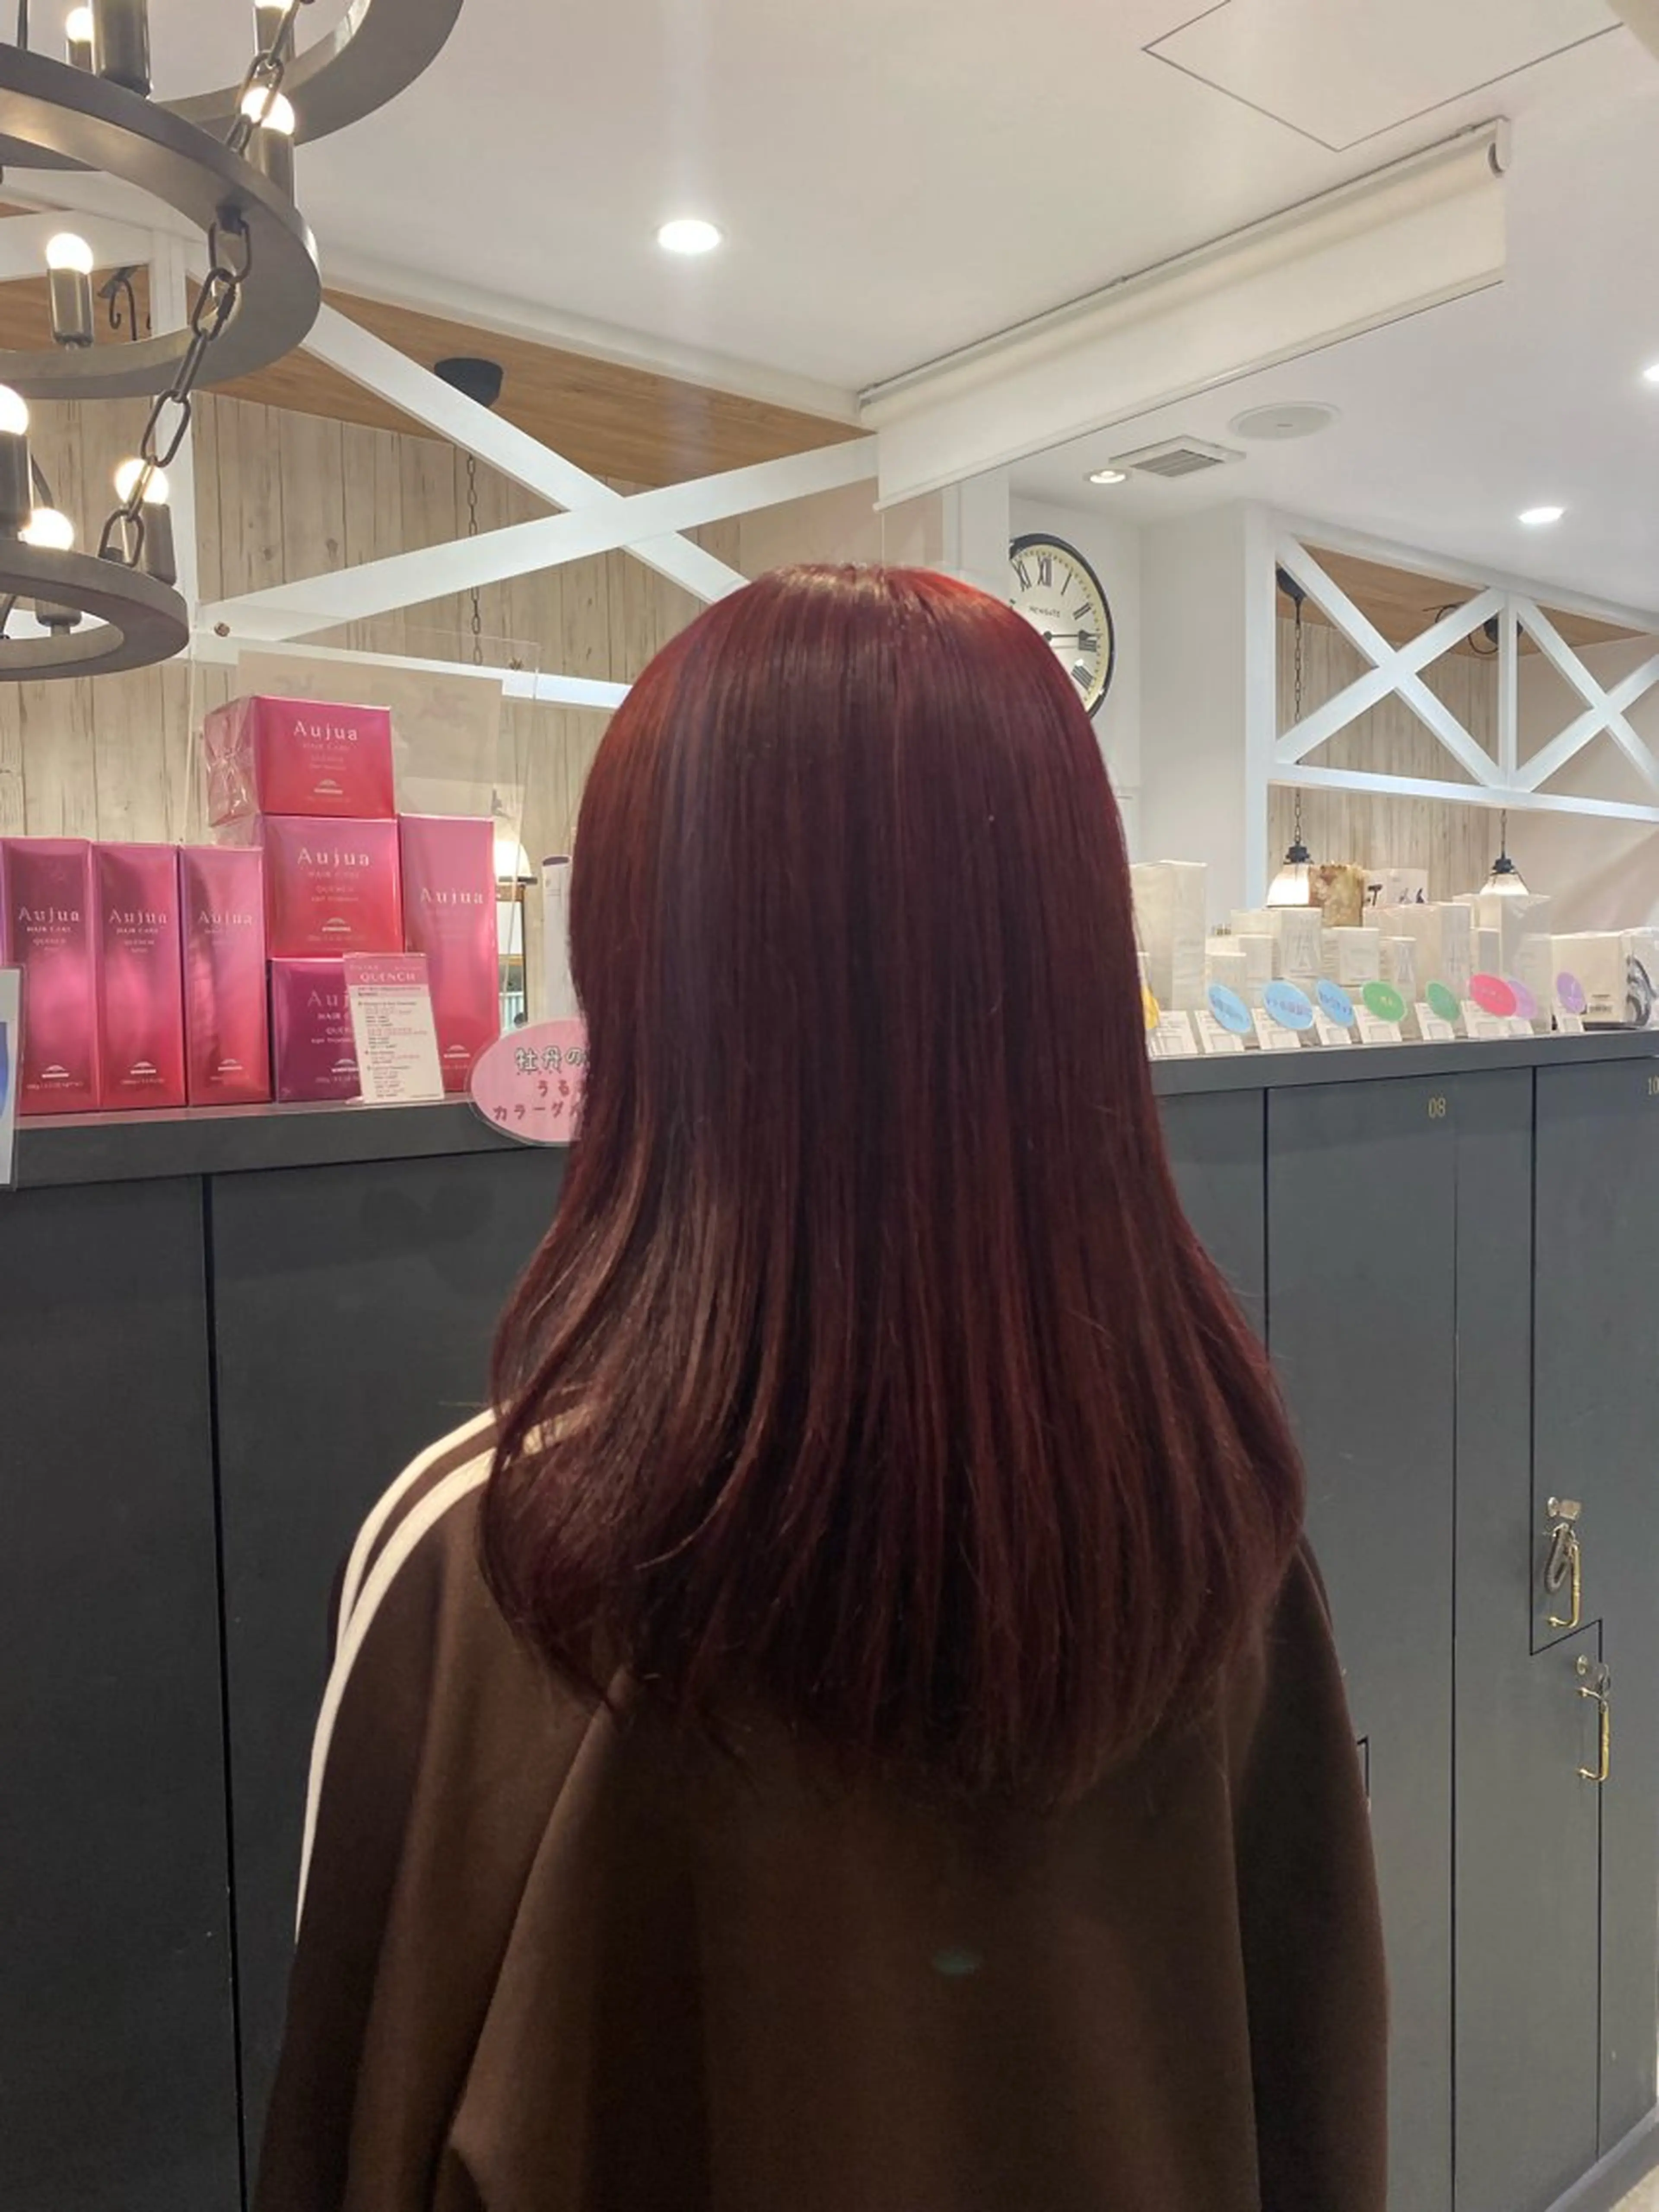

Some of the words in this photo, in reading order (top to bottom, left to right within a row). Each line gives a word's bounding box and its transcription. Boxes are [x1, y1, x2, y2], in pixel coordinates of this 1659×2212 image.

[294, 720, 358, 741] Aujua
[297, 847, 369, 868] Aujua
[420, 887, 483, 906] Aujua
[19, 906, 79, 923] Aujua
[109, 909, 167, 925] Aujua
[1428, 1097, 1446, 1119] 08
